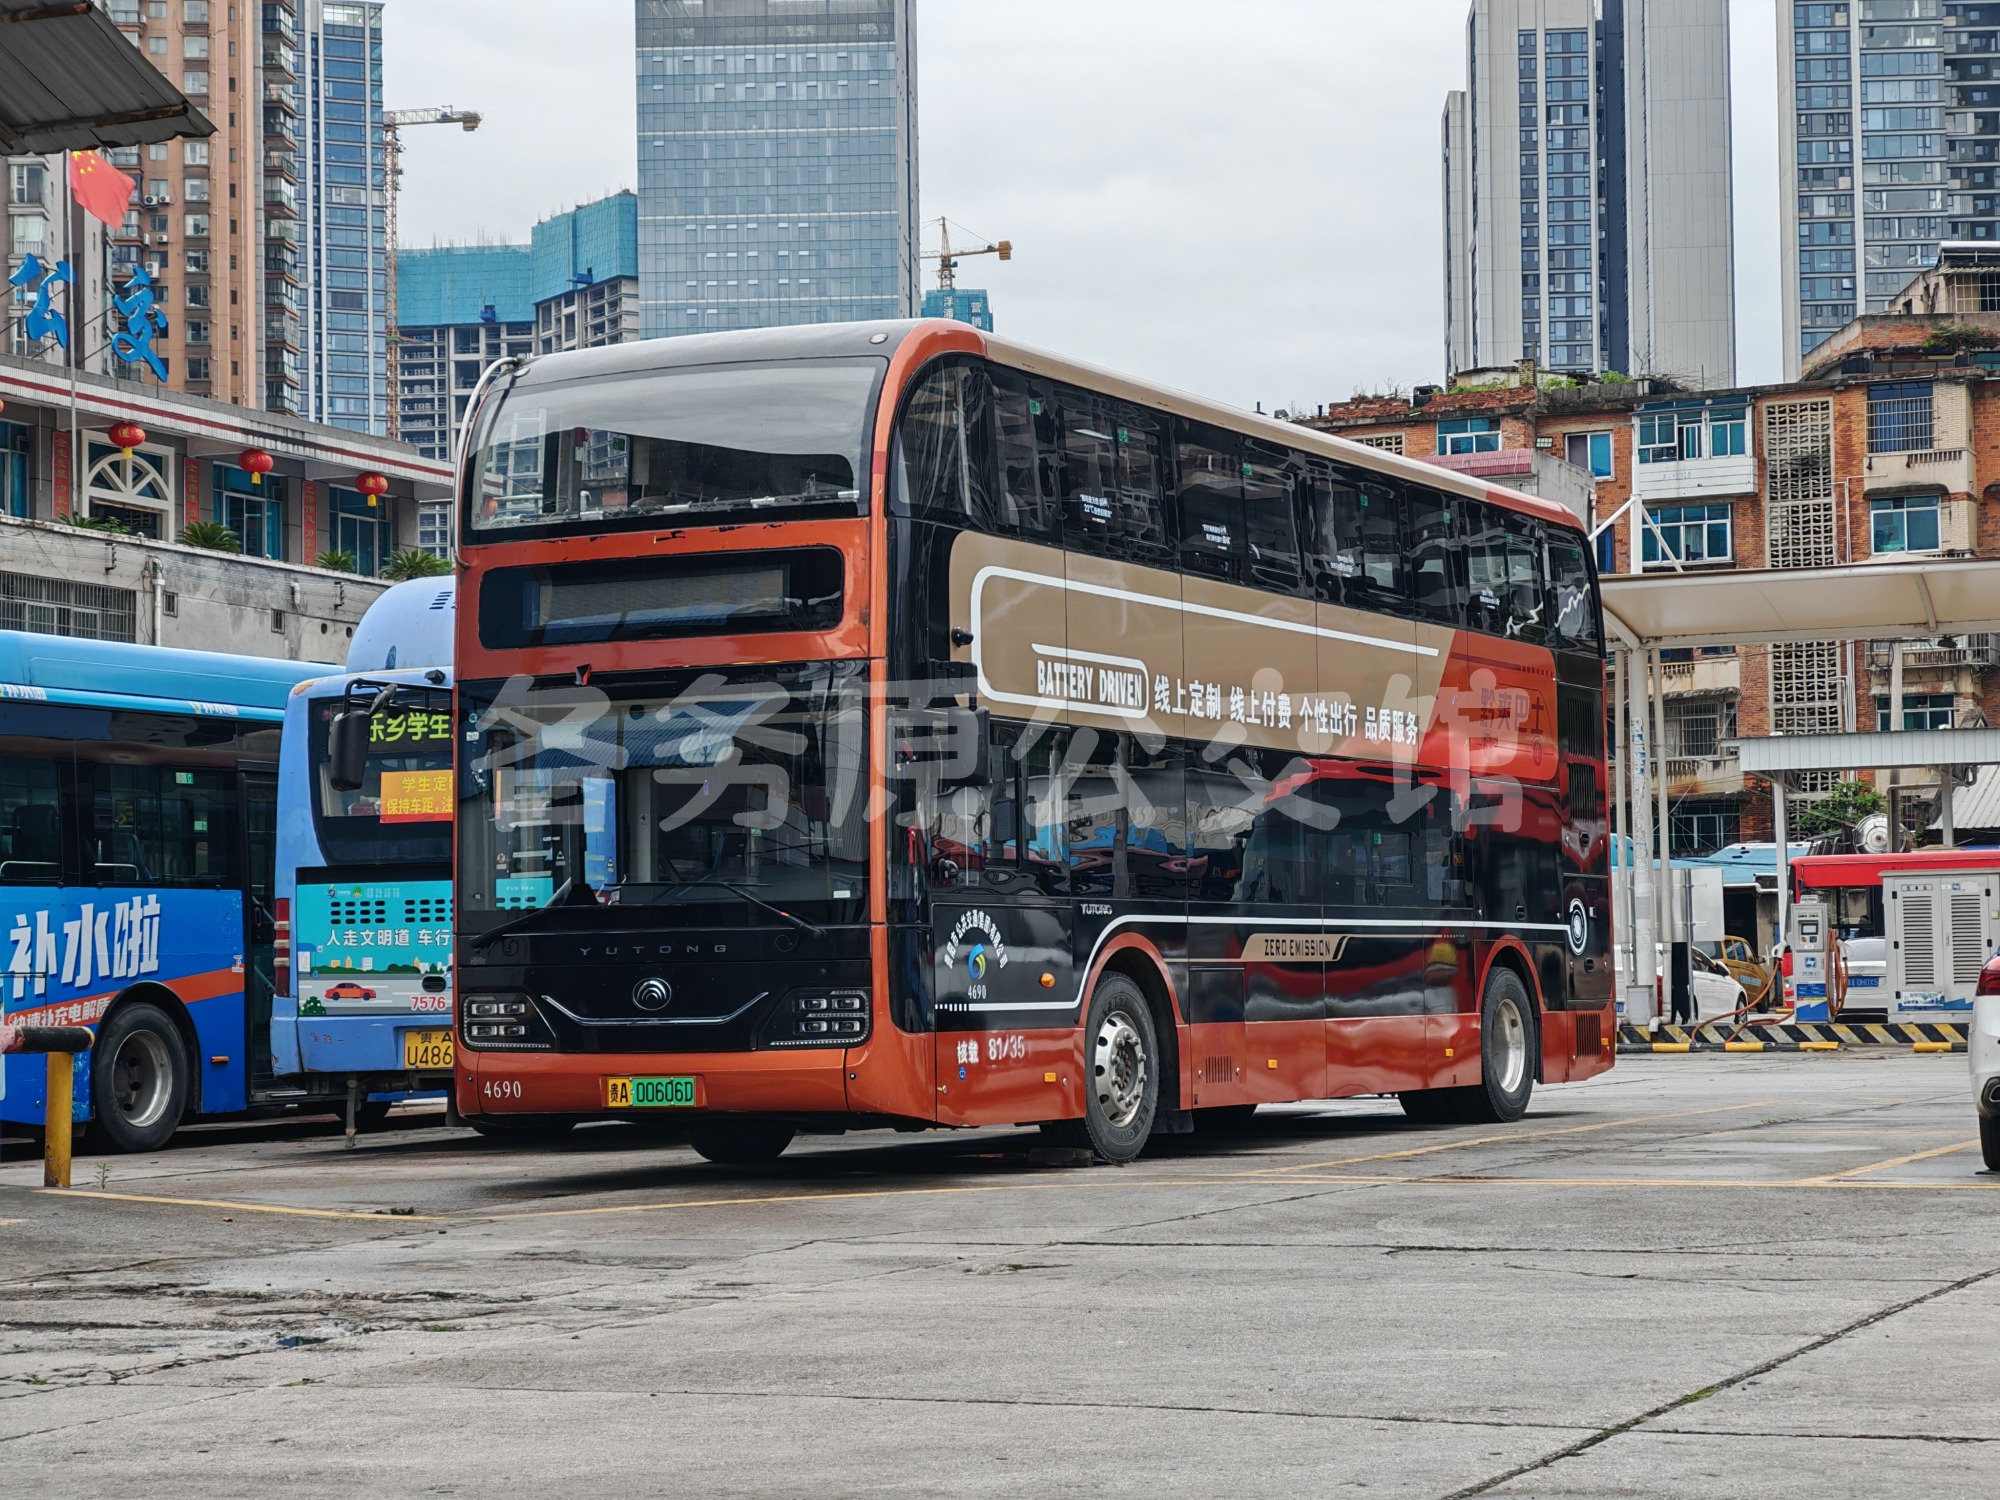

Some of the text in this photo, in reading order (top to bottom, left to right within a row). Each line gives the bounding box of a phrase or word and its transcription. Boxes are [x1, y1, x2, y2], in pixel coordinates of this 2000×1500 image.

[1038, 660, 1142, 707] BATTERY DRIVEN
[1154, 674, 1419, 745] 线上定制 线上付费 个性出行 品质服务
[369, 711, 453, 742] 乐乡学生
[402, 775, 453, 793] 学生定
[1080, 904, 1112, 915] YUTONG
[8, 894, 160, 998] 补水啦
[326, 929, 451, 947] 人走文明道 车行
[580, 944, 727, 956] YUTONG
[1264, 939, 1331, 957] ZERO EMISSION
[967, 984, 987, 1000] 4690
[411, 996, 447, 1011] 7576
[989, 1035, 1025, 1061] 81/35
[484, 1080, 522, 1099] 4690
